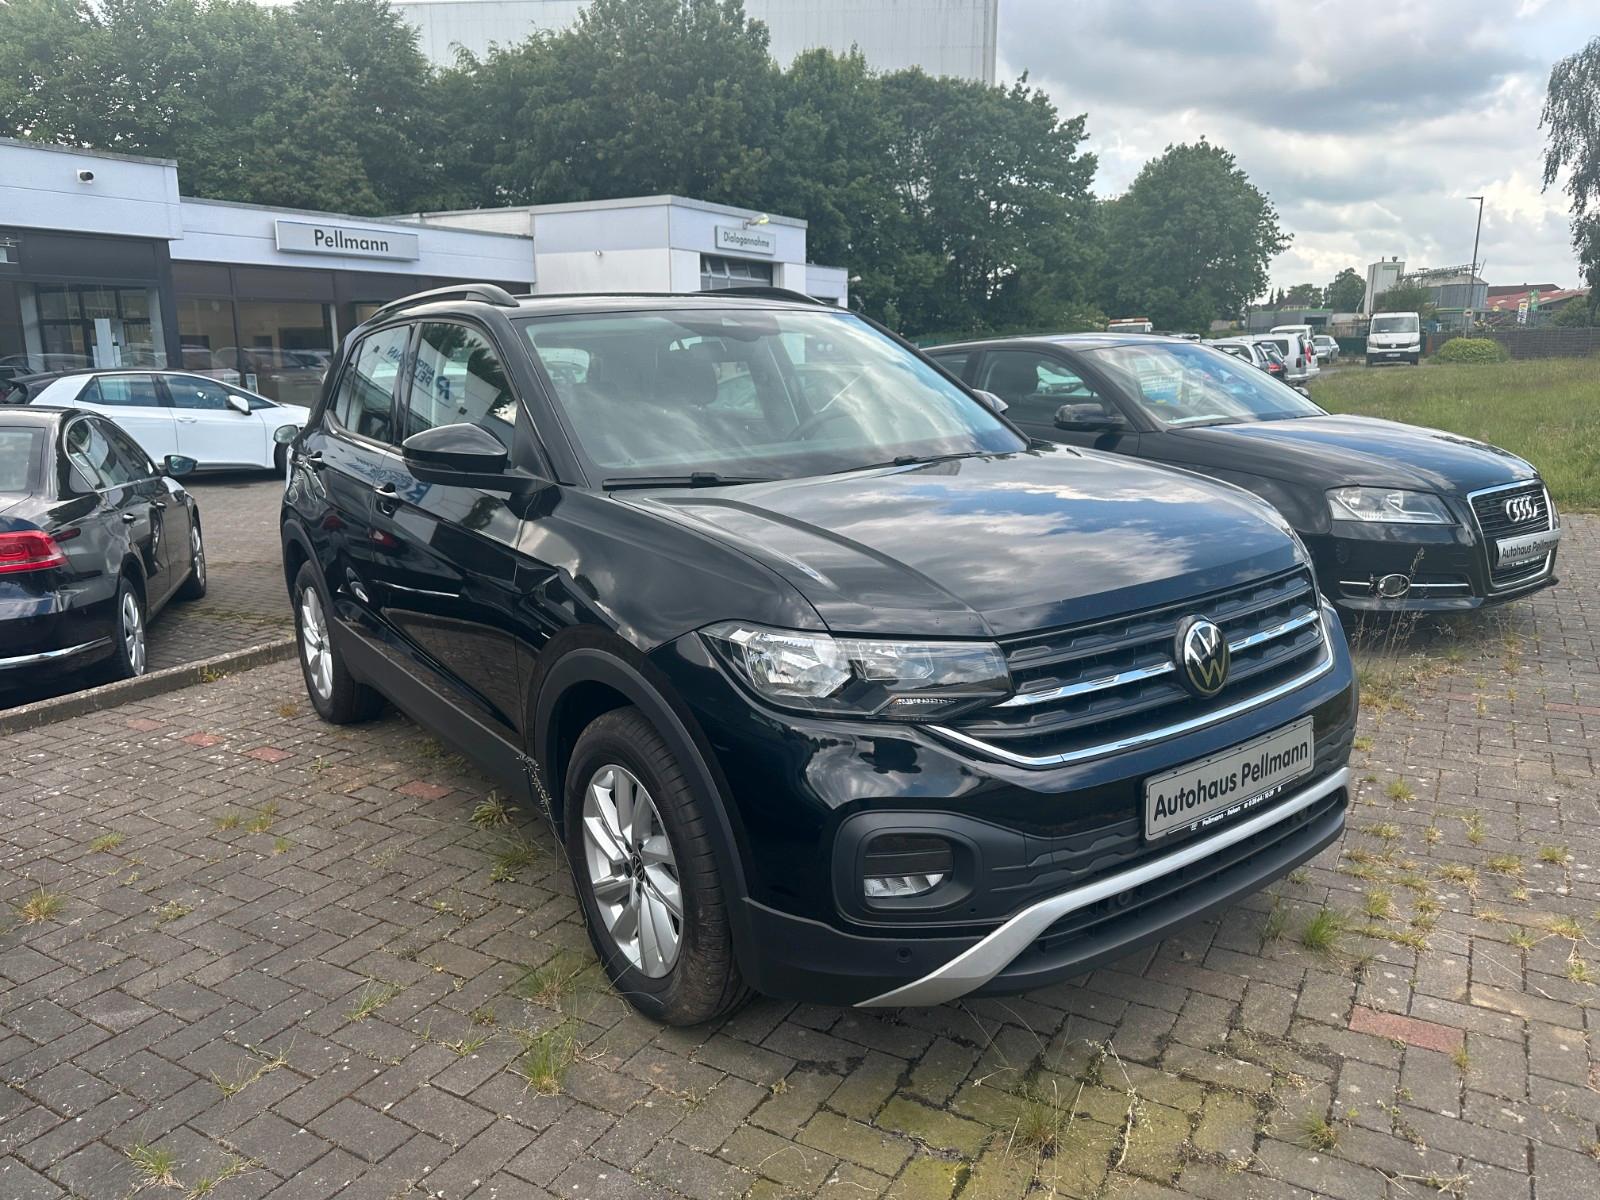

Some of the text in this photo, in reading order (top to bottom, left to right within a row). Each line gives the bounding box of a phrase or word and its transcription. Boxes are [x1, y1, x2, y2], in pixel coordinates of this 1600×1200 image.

[314, 229, 389, 252] Pellmann
[1502, 544, 1532, 559] Autohaus
[1153, 741, 1308, 821] Autohaus Pellmann
